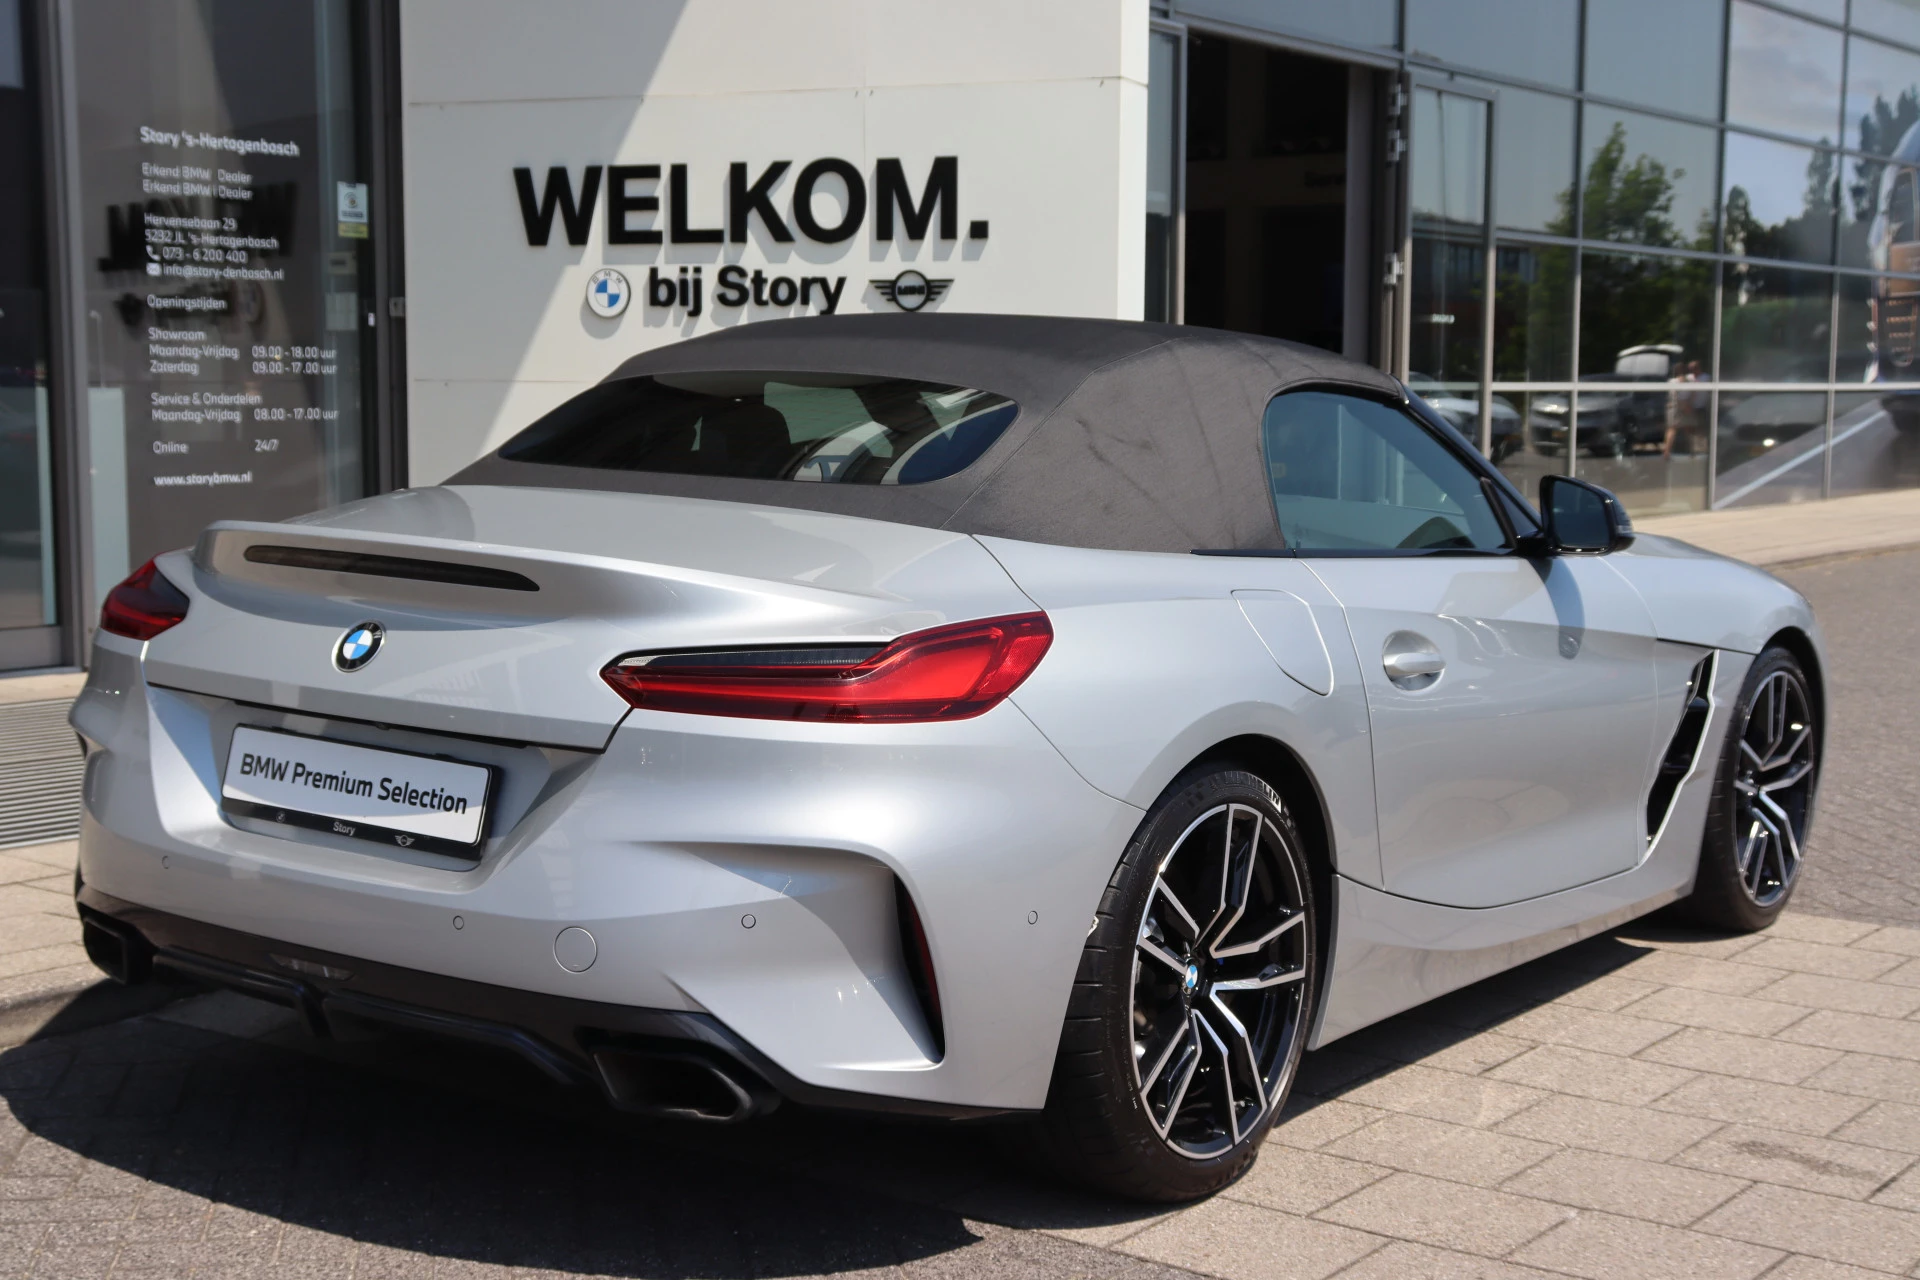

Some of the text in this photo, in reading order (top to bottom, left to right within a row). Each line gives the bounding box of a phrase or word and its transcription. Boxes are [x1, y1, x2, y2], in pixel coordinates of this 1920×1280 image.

[140, 127, 299, 155] Story 's-Hertogenbosch
[142, 162, 253, 184] Erkend BMW Dealer
[142, 179, 180, 194] Erkend
[182, 182, 211, 197] BMW
[218, 185, 254, 200] Dealer
[513, 156, 989, 246] WELKOM.
[222, 217, 238, 231] 29
[162, 246, 184, 260] 073
[225, 250, 248, 263] 400
[648, 265, 847, 316] bij Story
[147, 294, 227, 312] Openingstijden
[148, 328, 205, 341] Showroom
[149, 344, 239, 361] Maandag-Vrijdag
[251, 345, 283, 359] 09.00
[320, 349, 337, 359] uur
[150, 360, 200, 376] Zaterdag
[252, 361, 283, 375] 09.00
[320, 364, 338, 374] uur
[151, 392, 263, 406] Service & Onderdelen
[151, 408, 242, 424] Maandag-Vrijdag
[253, 407, 285, 421] 08.00
[322, 410, 339, 420] uur
[152, 439, 280, 455] Online 24/7
[153, 471, 252, 486] www.storybmw.nl
[240, 753, 468, 815] BMW Premium Selection
[332, 821, 356, 837] Story
